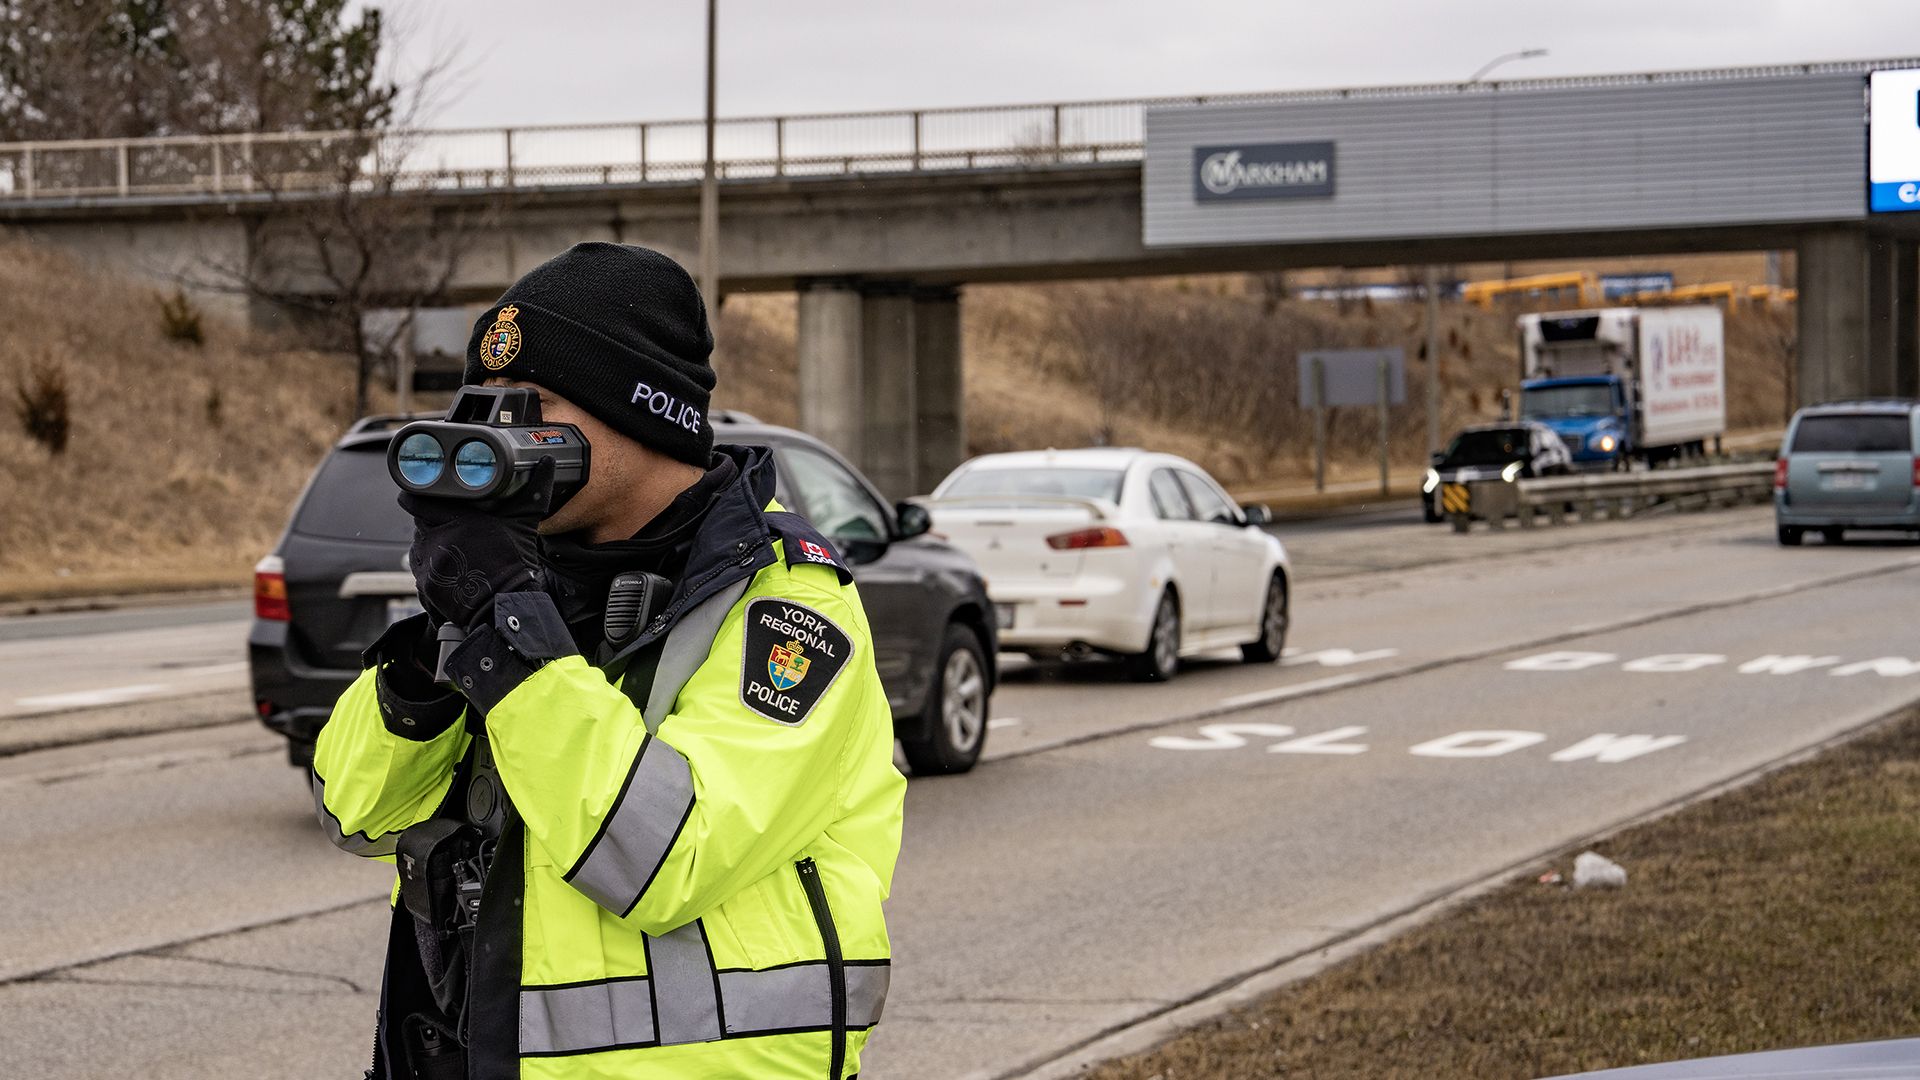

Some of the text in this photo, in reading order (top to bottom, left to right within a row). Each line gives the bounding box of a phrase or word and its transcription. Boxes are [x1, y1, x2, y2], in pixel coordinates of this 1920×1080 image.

[1201, 151, 1327, 194] MARKHAM
[496, 322, 519, 350] REGIONAL
[482, 353, 509, 367] POLICE
[631, 382, 701, 434] POLICE
[760, 613, 836, 658] REGIONAL
[781, 606, 828, 637] YORK
[747, 681, 801, 715] POLICE
[1149, 723, 1688, 763] SLOW
